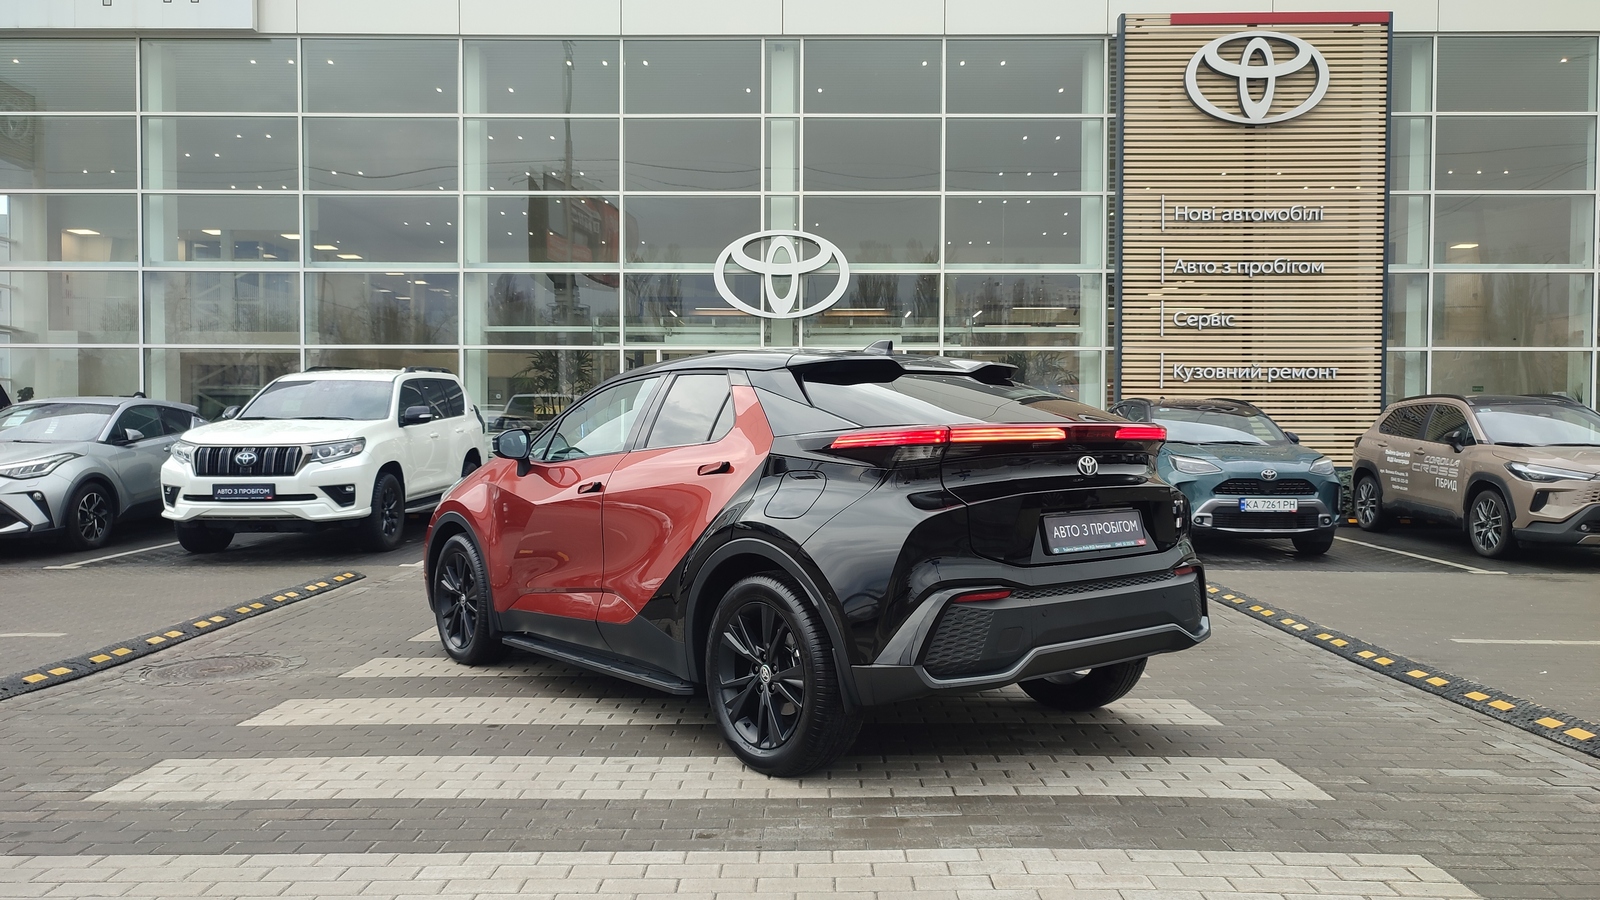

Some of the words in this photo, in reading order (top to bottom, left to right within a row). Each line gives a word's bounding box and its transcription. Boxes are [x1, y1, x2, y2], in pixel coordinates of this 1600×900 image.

[1173, 205, 1216, 222] Нові
[1221, 204, 1325, 222] автомобілі
[1173, 258, 1217, 275] Авто
[1236, 258, 1325, 278] пробігом
[1173, 311, 1236, 331] Сервіс
[1173, 362, 1263, 383] Кузовний
[1267, 366, 1339, 383] ремонт
[1411, 462, 1459, 478] CROSS
[1423, 455, 1461, 468] COROLLA
[1261, 500, 1281, 509] 7261
[1053, 524, 1080, 539] АВТО
[1090, 519, 1139, 536] ПРОБІГОМ
